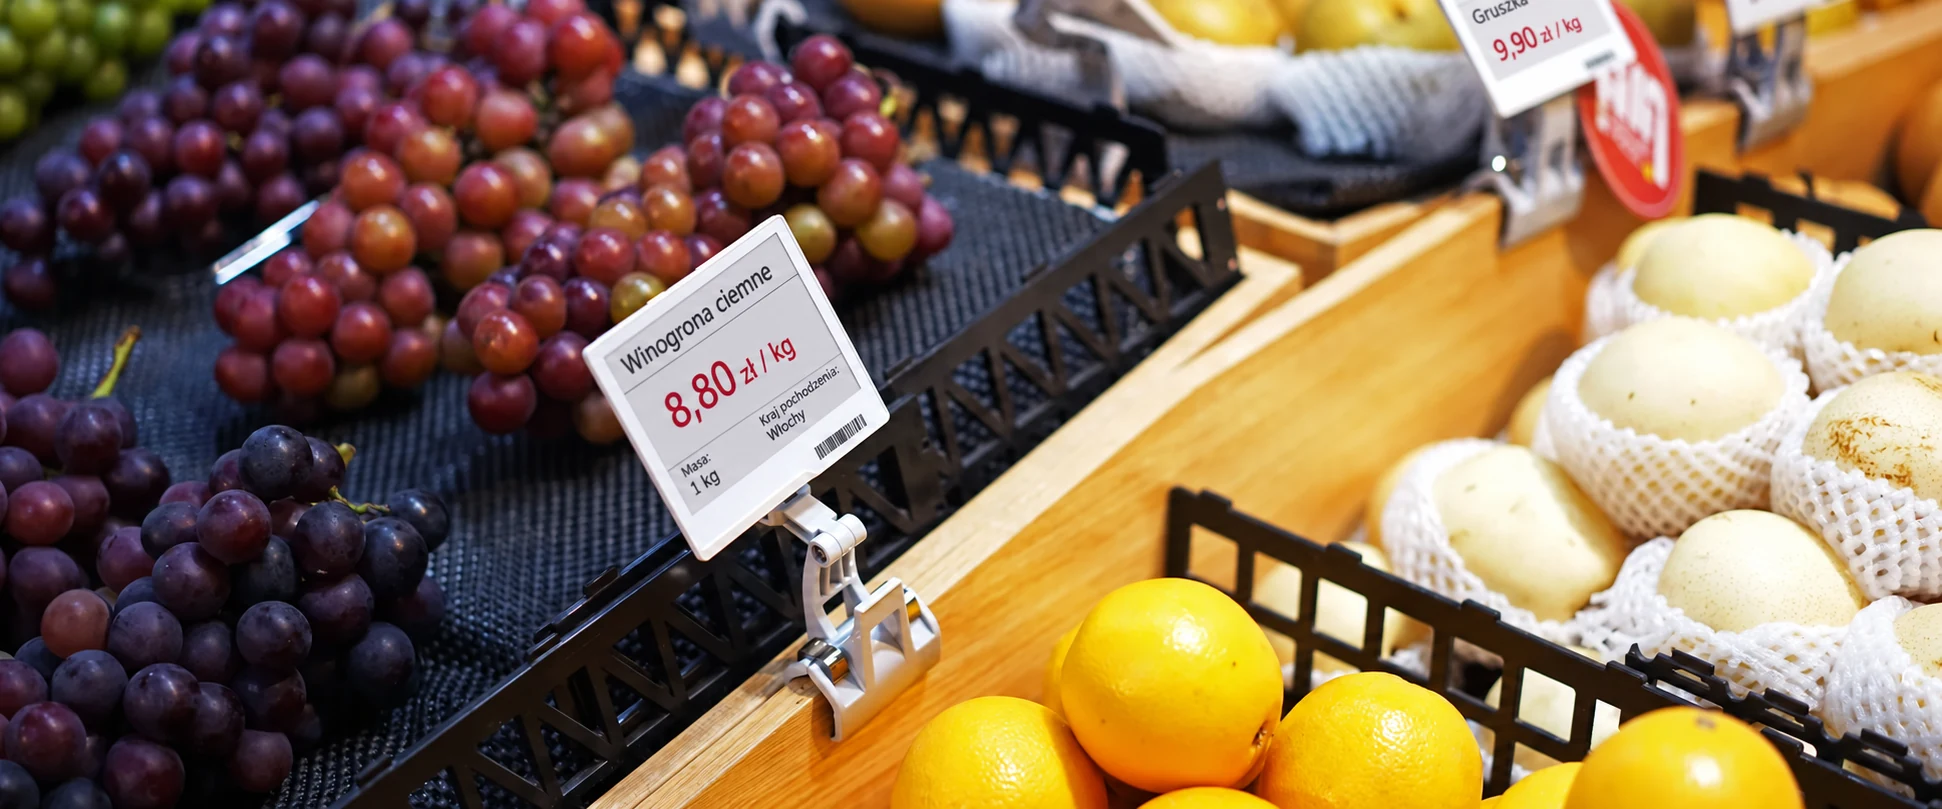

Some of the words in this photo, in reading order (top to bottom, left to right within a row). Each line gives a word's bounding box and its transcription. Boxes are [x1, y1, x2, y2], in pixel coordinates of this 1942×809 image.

[1493, 26, 1538, 61] 9,90
[1561, 17, 1583, 33] kg
[620, 307, 714, 374] Winogrona
[715, 264, 773, 313] ciemne
[664, 360, 736, 428] 8,80
[739, 357, 758, 384] zł
[759, 349, 767, 373] /
[767, 337, 796, 363] kg
[759, 404, 780, 426] Kraj
[779, 365, 840, 415] pochodzenia:
[680, 453, 712, 478] Masa:
[690, 481, 700, 495] 1
[699, 468, 721, 489] kg
